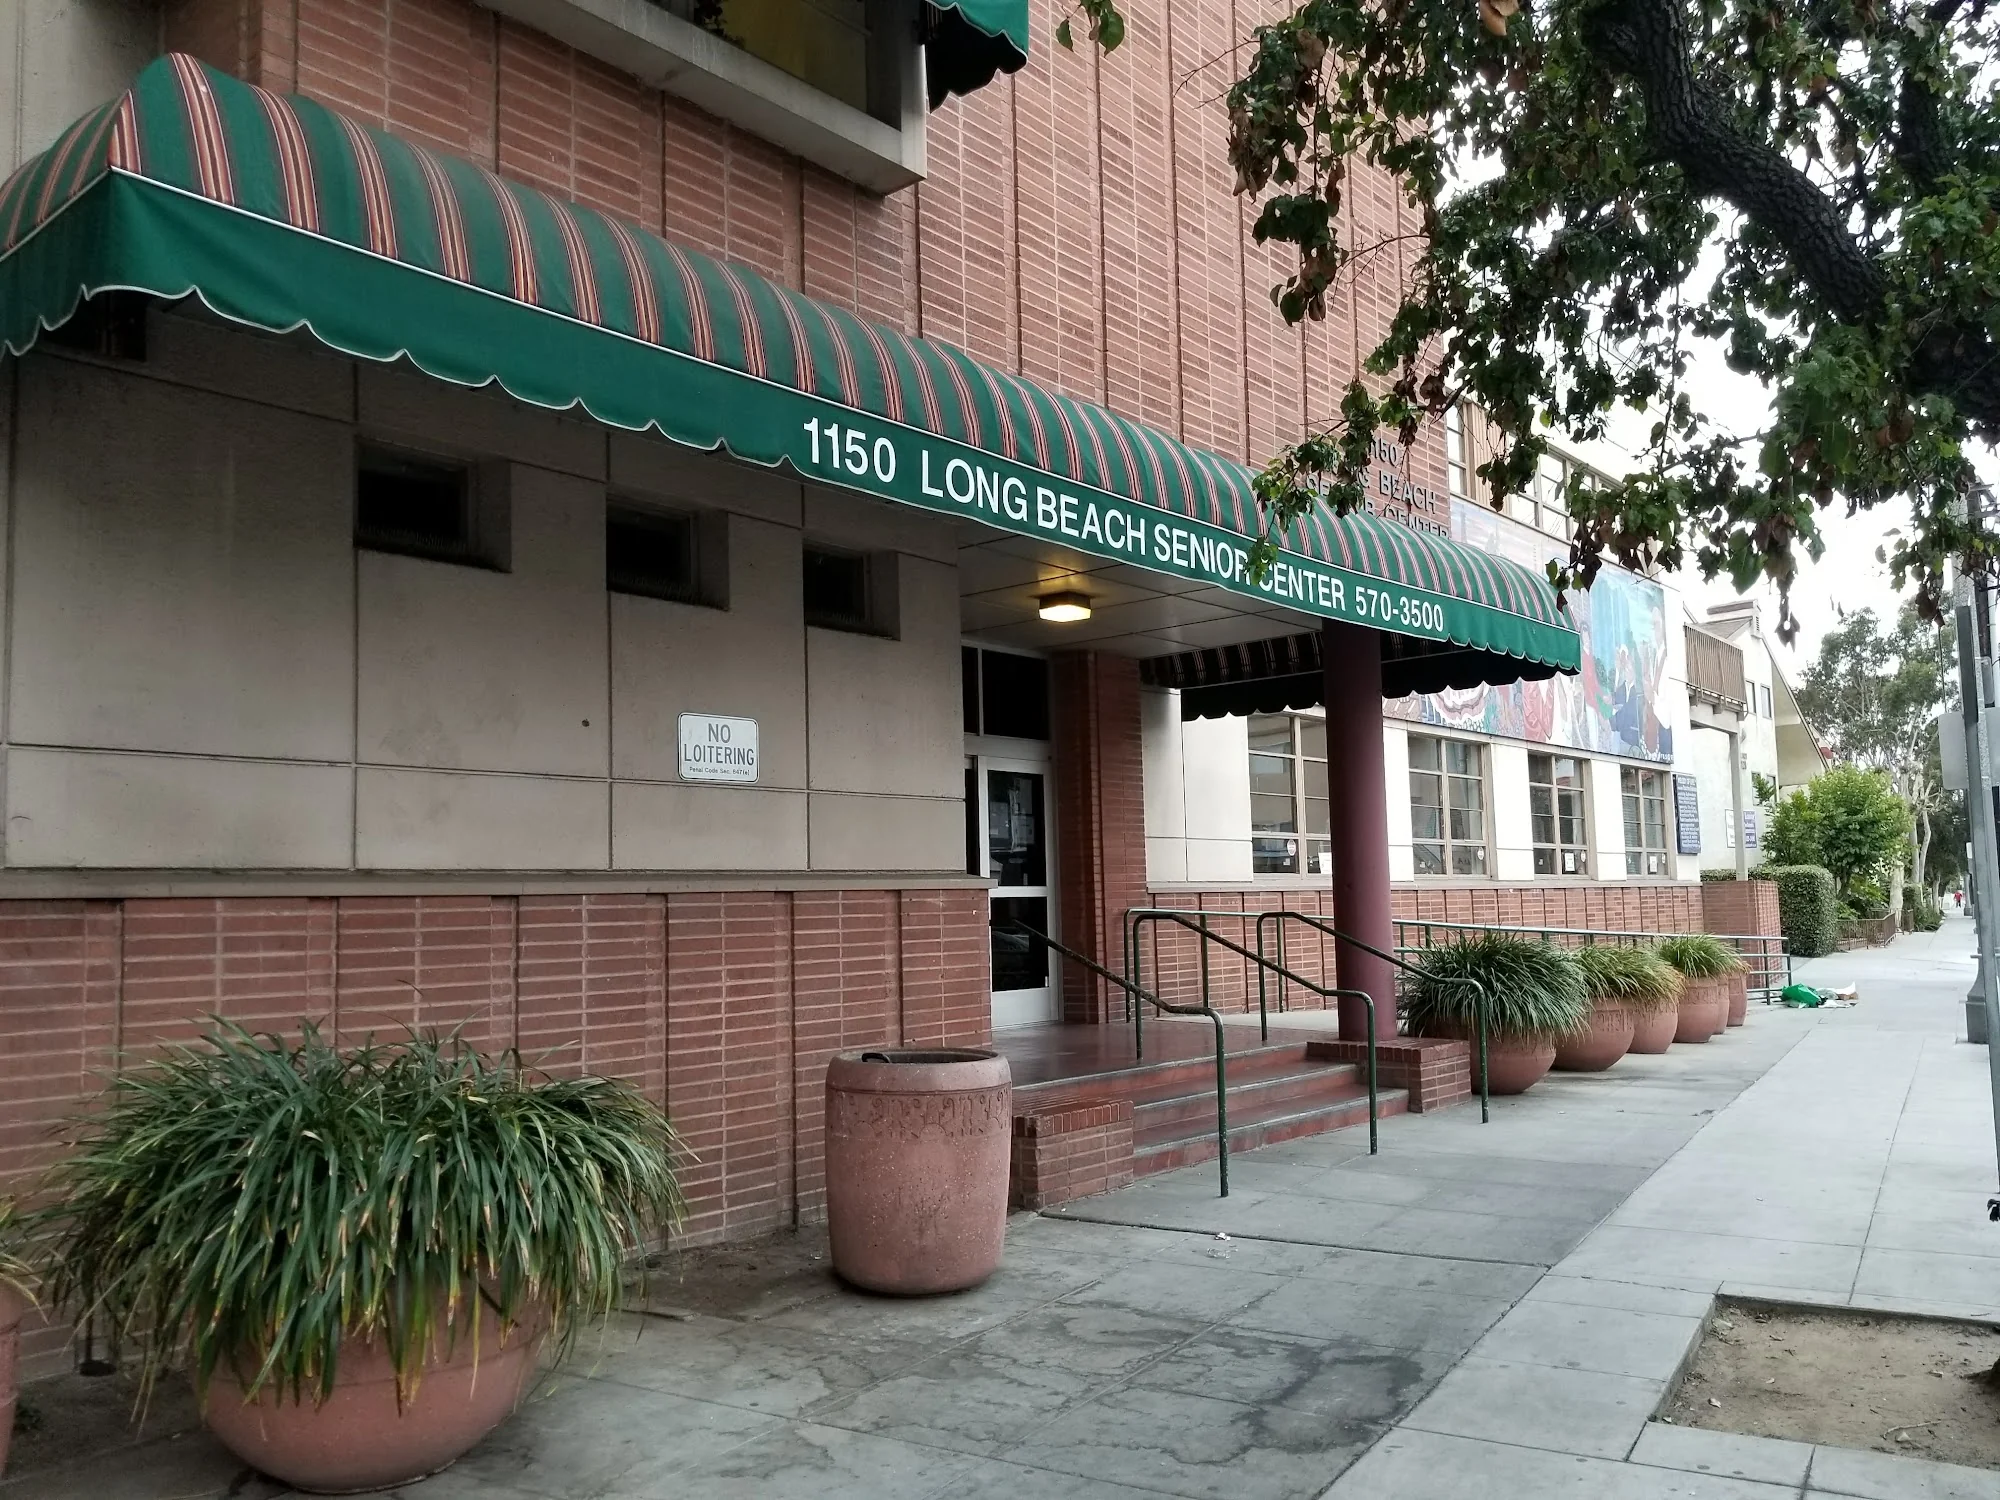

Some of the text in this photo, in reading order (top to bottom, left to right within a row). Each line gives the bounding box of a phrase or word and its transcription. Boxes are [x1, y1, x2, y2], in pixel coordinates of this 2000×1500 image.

[1379, 470, 1436, 514] BEACH
[803, 417, 897, 483] 1150
[921, 450, 1028, 522] LONG
[1036, 486, 1146, 556] BEACH
[1355, 586, 1444, 632] 570-3500
[708, 723, 731, 743] NO
[684, 744, 755, 766] LOITERING
